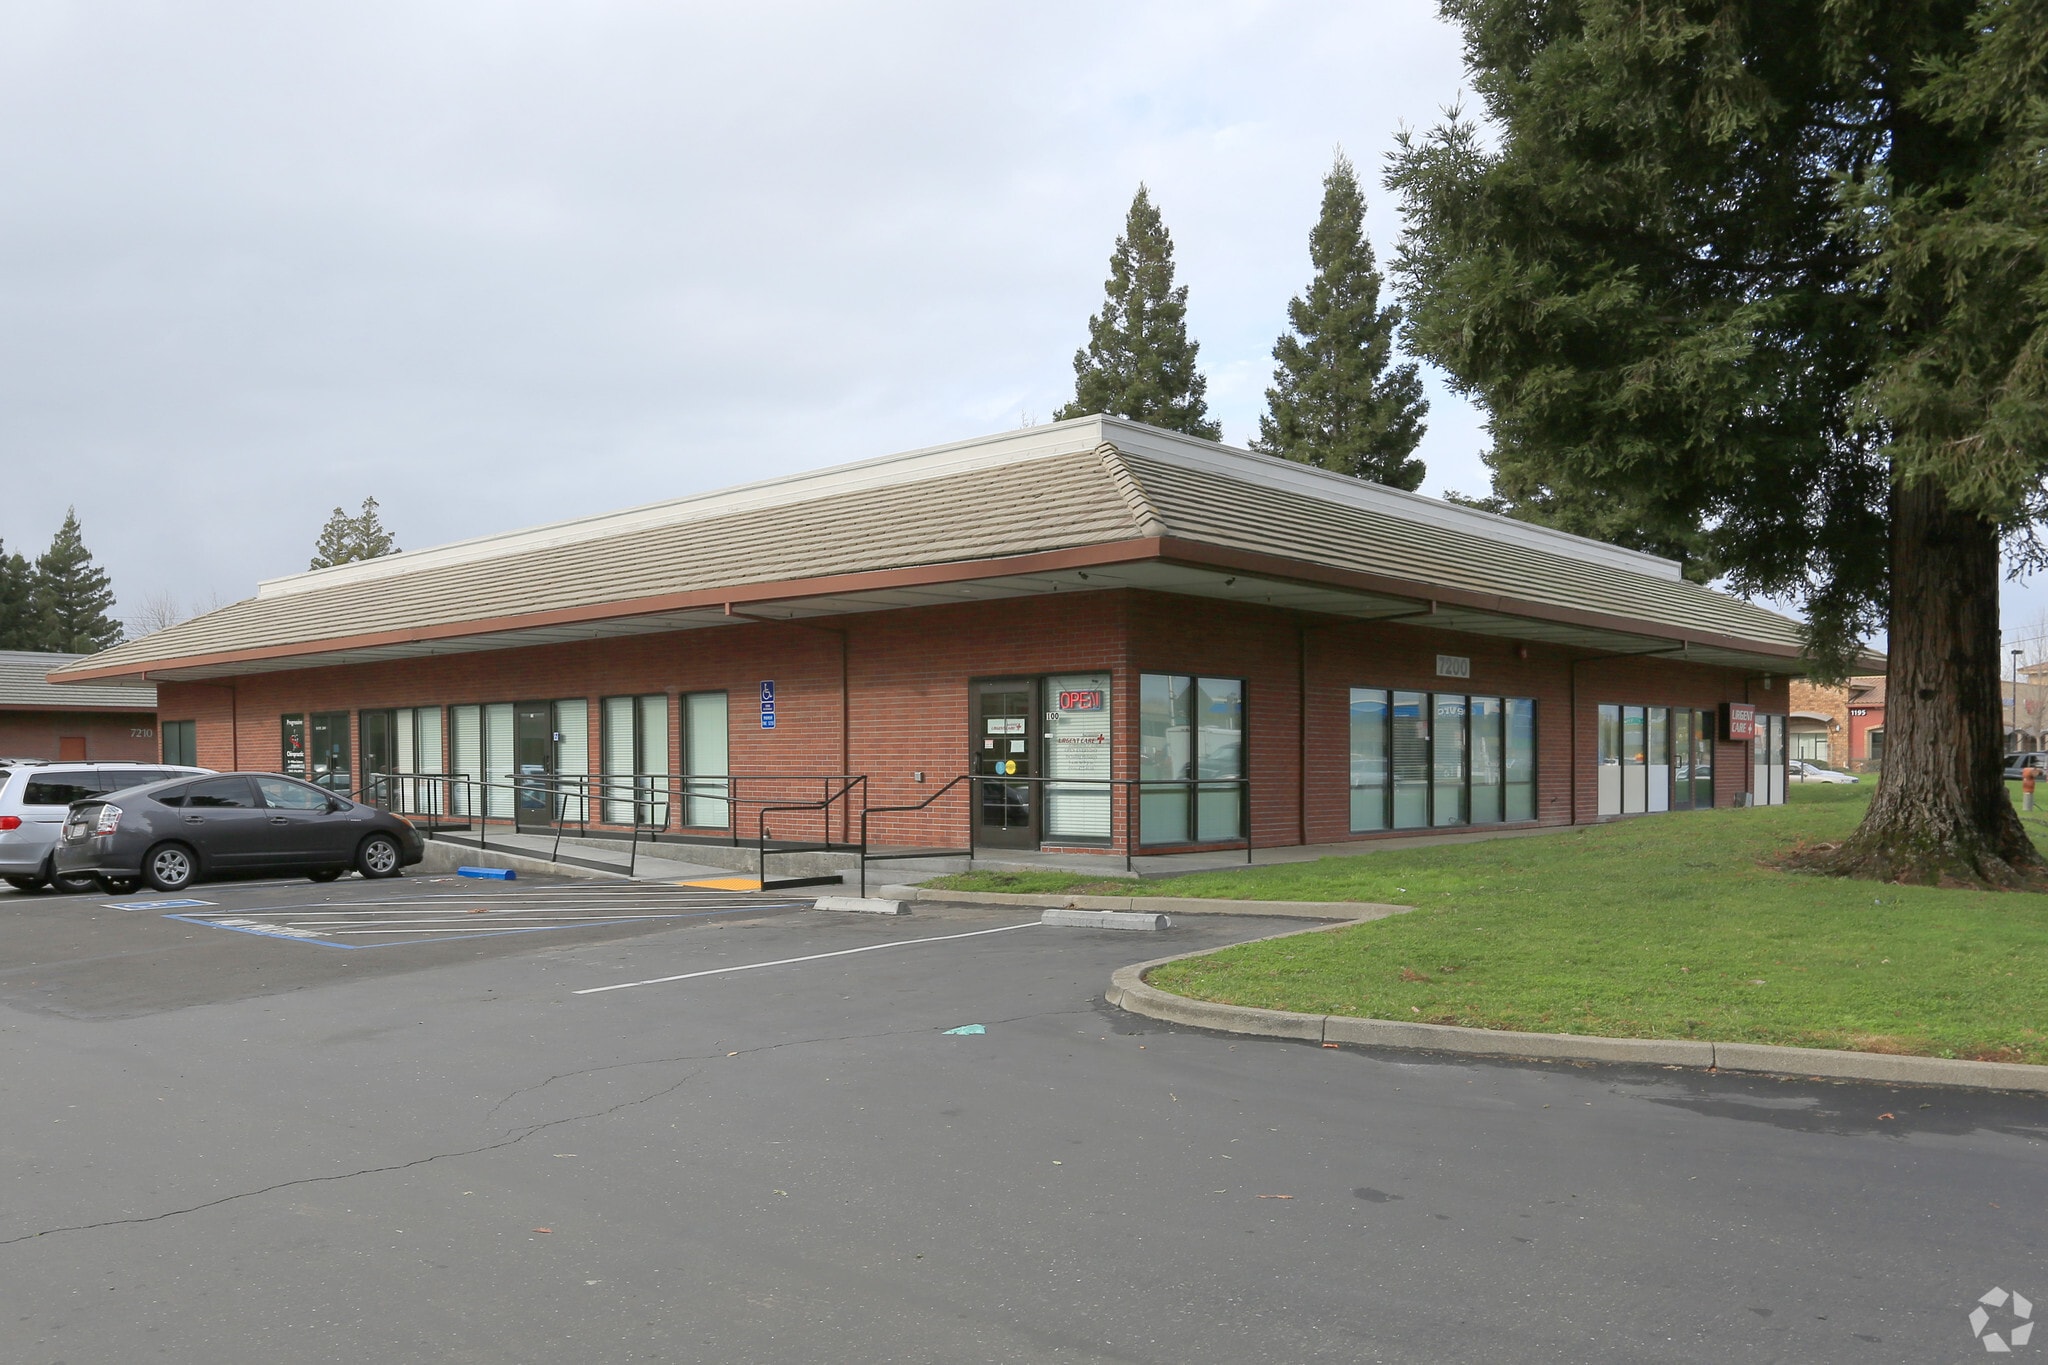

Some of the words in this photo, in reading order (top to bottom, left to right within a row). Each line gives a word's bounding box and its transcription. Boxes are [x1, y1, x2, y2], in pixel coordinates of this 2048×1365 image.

[1440, 657, 1467, 676] 7200
[1060, 691, 1100, 709] OPEN
[1047, 712, 1060, 720] 100
[1732, 710, 1753, 721] URGENT
[130, 728, 153, 738] 7210
[1731, 722, 1747, 733] CARE
